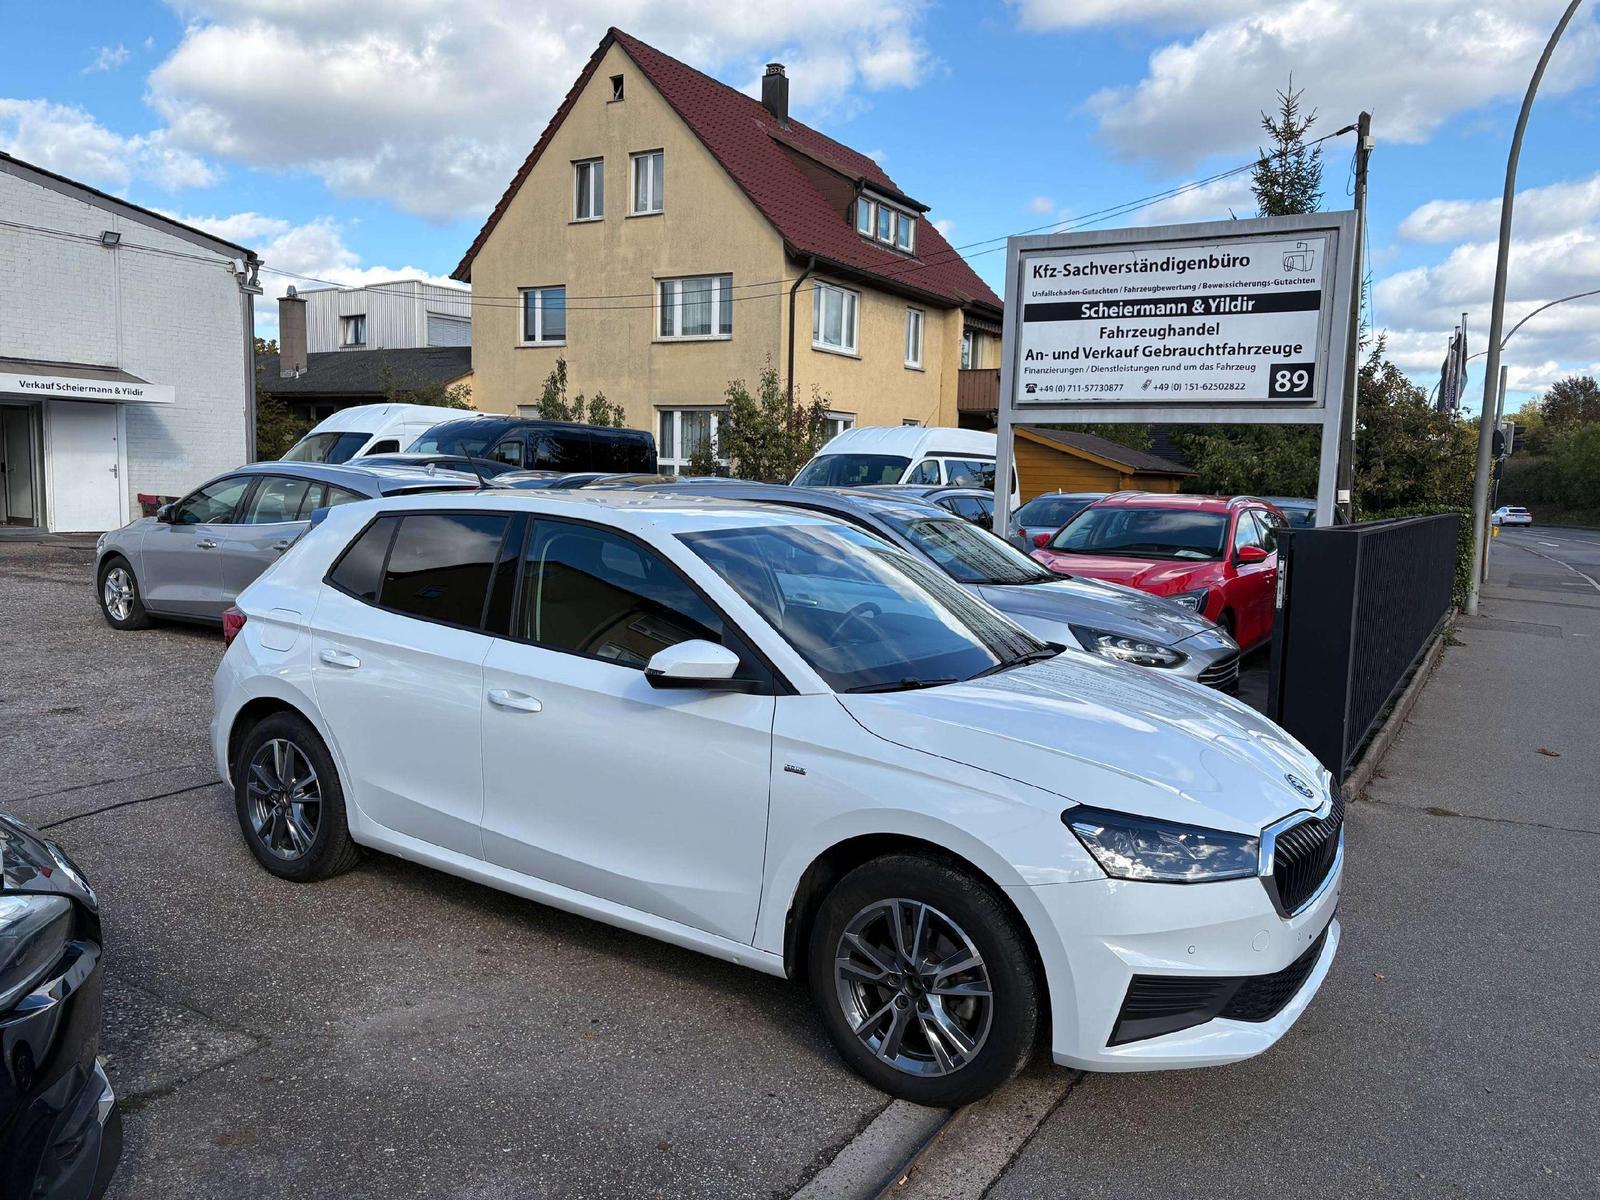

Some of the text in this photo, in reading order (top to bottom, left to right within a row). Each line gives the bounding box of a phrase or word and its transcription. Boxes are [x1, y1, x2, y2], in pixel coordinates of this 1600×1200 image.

[1033, 254, 1250, 279] Kfz-Sachverständigenbüro
[1032, 287, 1118, 297] Unfallschaden-Gutachten
[1124, 284, 1196, 293] Fahrzeugbewertung
[1081, 297, 1255, 318] Scheiermann & Yildir
[1100, 323, 1220, 339] Fahrzeughandel
[1025, 343, 1302, 361] An- und Verkauf Gebrauchtfahrzeuge
[1024, 367, 1084, 375] Finanzierungen
[1091, 365, 1159, 373] Dienstleistungen
[1216, 363, 1256, 372] Fahrzeug
[19, 380, 54, 390] Verkauf
[56, 383, 112, 394] Scheiermann
[122, 388, 143, 396] Yildir
[1274, 370, 1309, 393] 89
